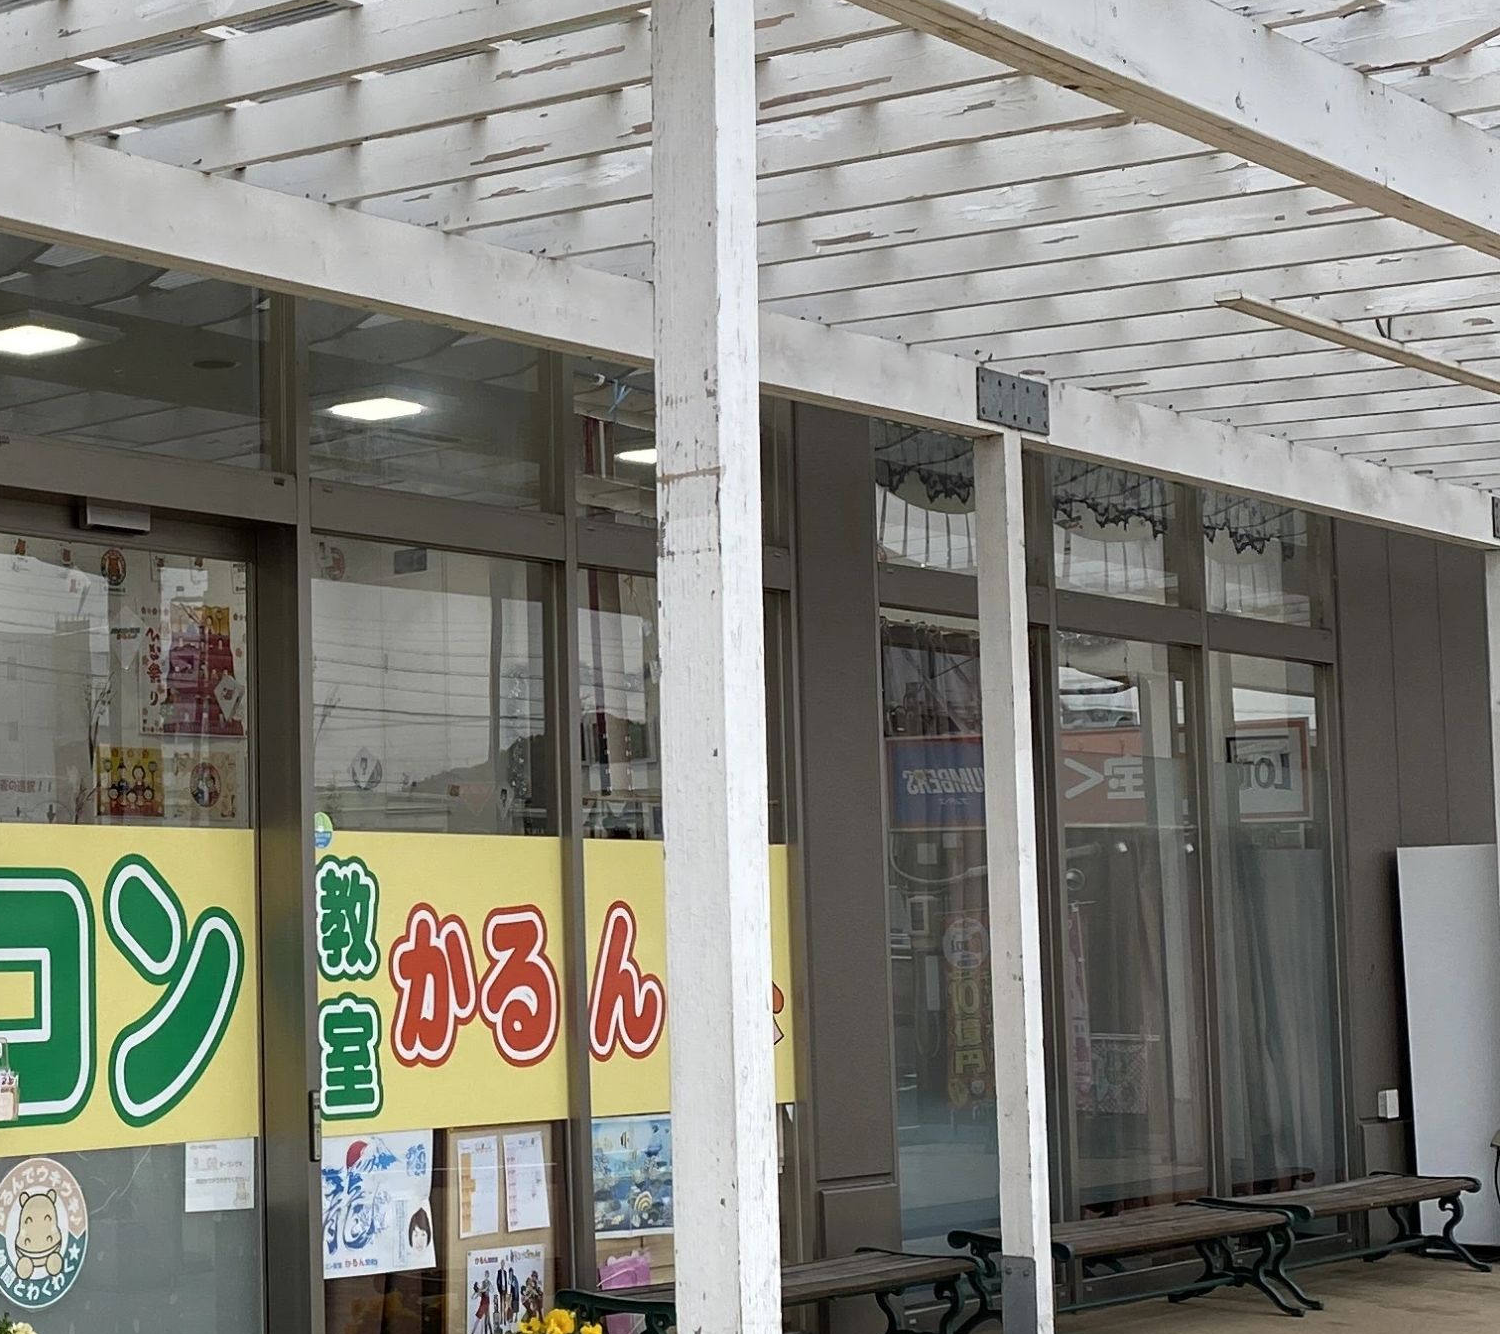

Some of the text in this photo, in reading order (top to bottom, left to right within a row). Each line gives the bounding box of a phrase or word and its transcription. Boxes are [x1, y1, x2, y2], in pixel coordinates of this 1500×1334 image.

[316, 854, 383, 1119] 教室
[389, 900, 666, 1069] かるん
